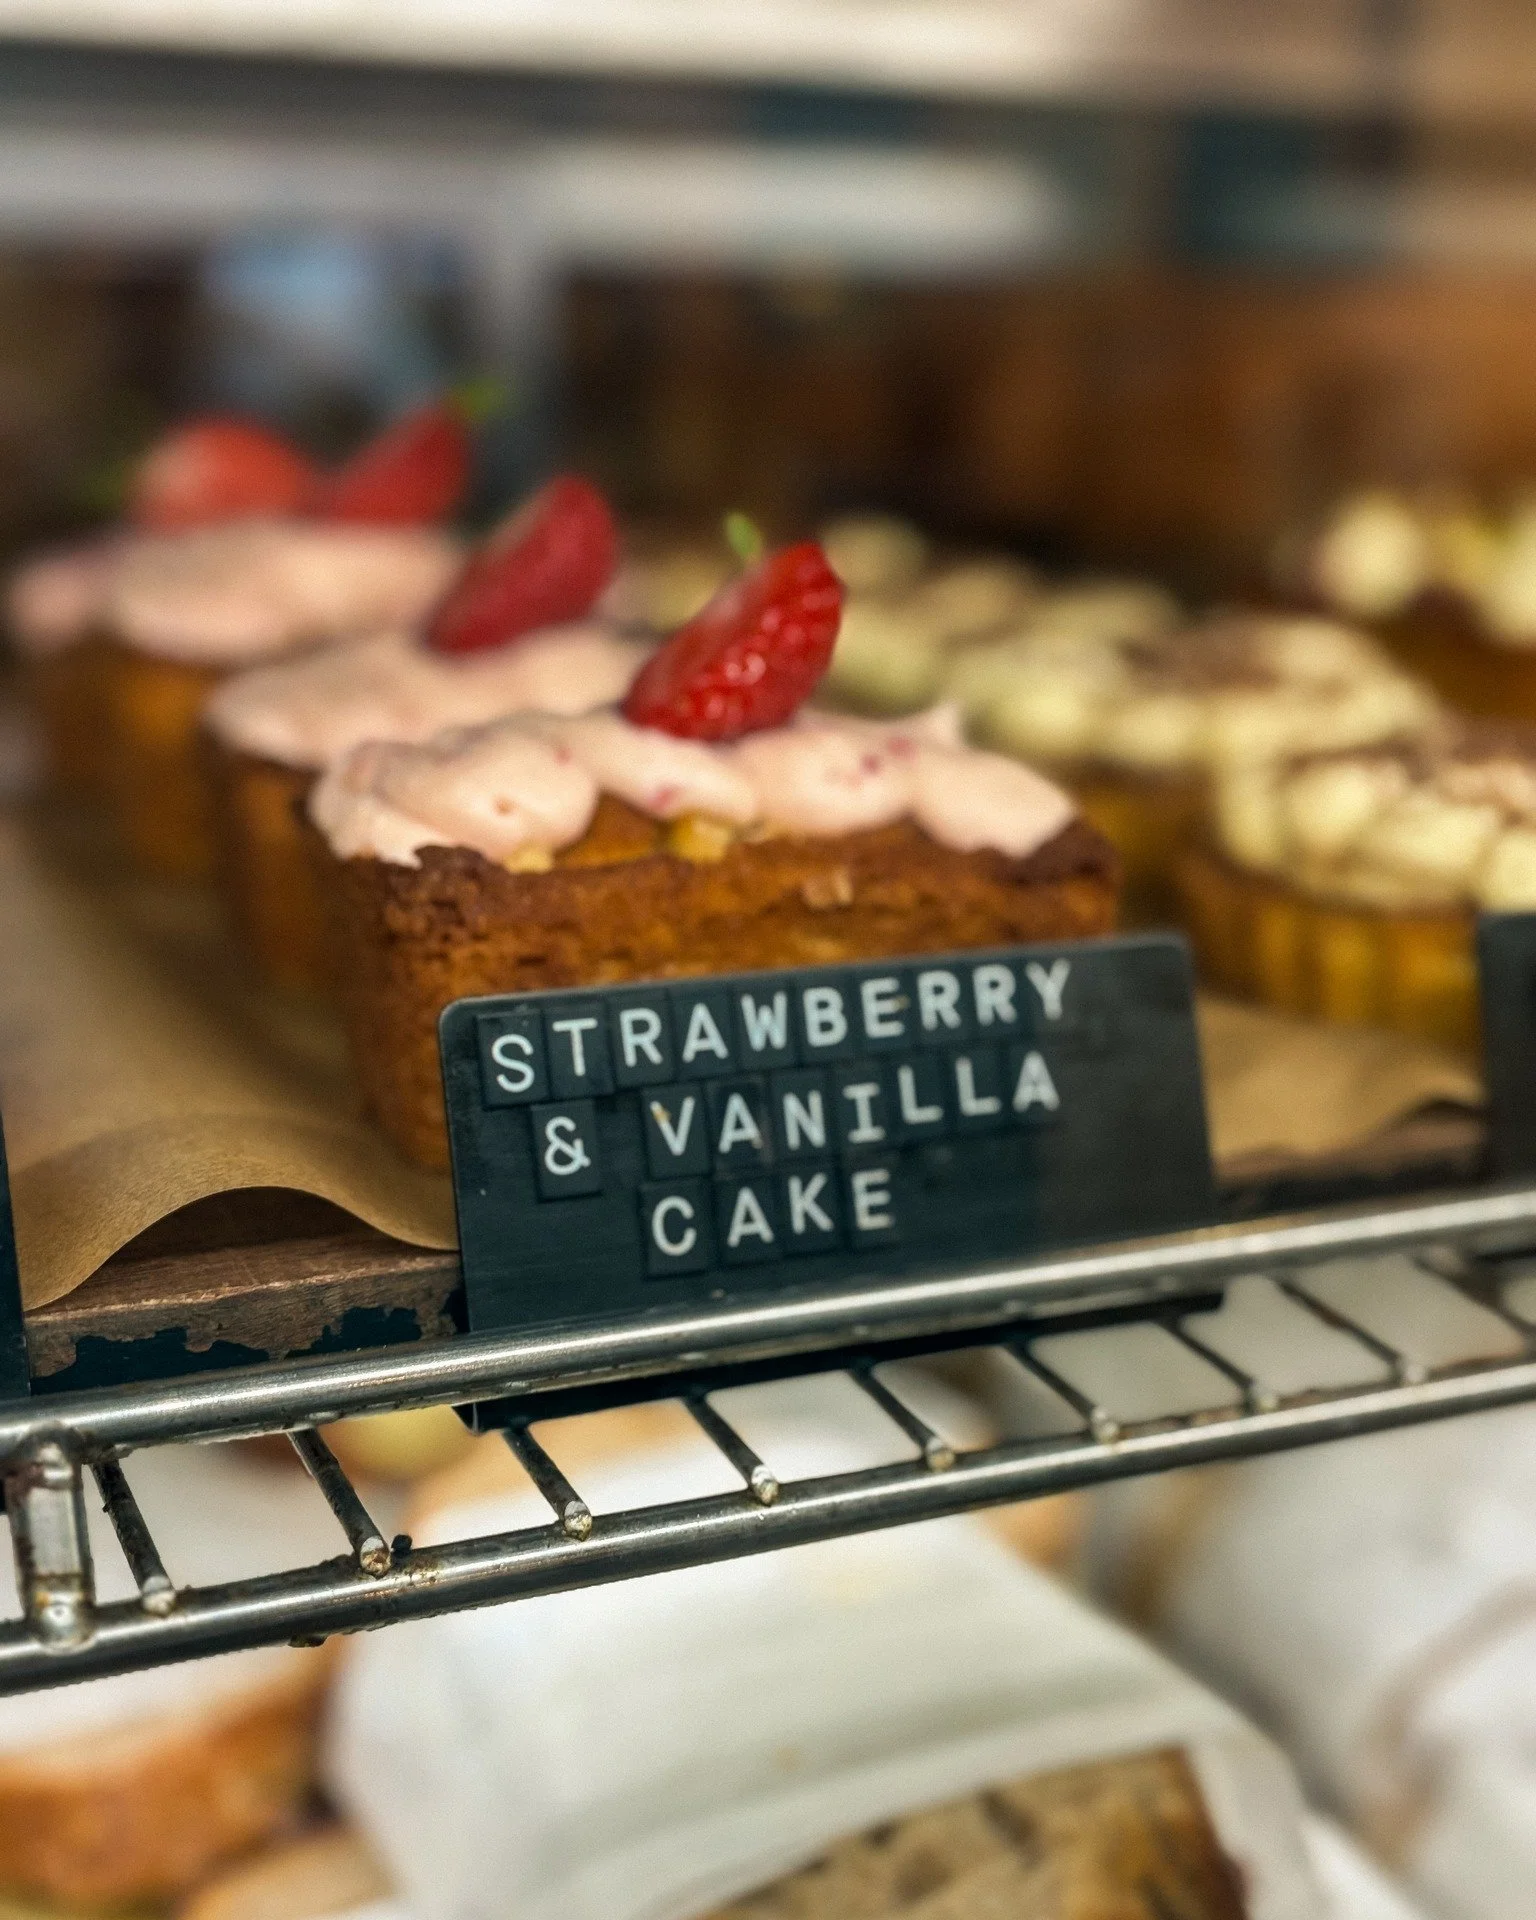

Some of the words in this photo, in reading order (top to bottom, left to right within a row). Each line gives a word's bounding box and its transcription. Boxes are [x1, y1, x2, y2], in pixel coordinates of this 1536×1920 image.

[491, 959, 1071, 1092] STRAWBERRY
[544, 1116, 591, 1175] &
[650, 1051, 1059, 1156] VANILLA
[652, 1168, 896, 1256] CAKE
